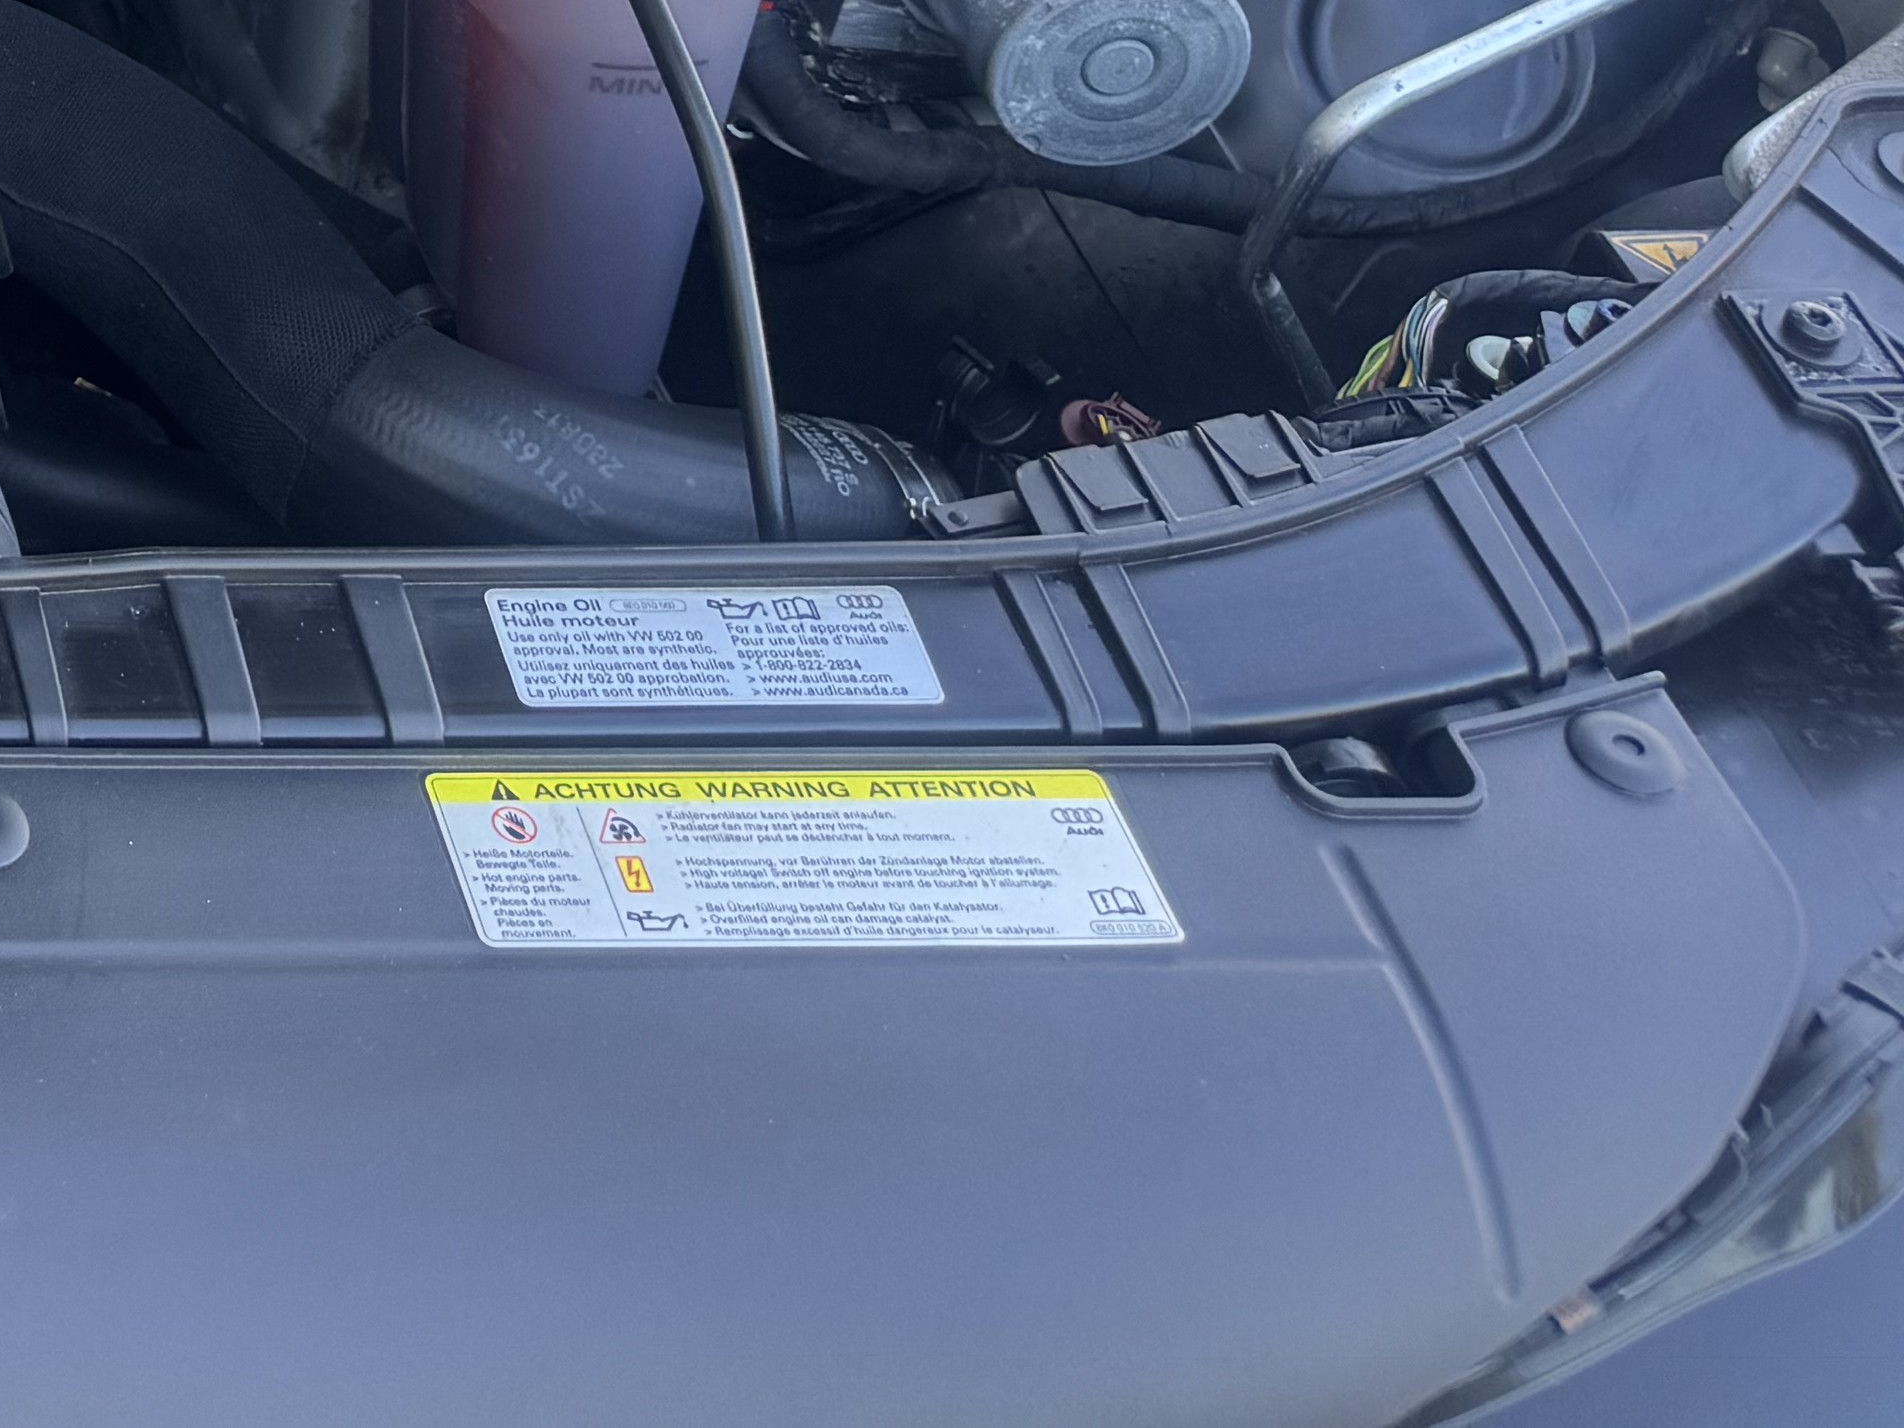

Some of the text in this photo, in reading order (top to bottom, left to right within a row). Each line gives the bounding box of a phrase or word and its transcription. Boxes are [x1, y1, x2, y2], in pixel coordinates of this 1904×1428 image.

[588, 76, 662, 94] MIN
[497, 599, 602, 614] Engine Oil
[502, 615, 639, 627] Huile moteur
[849, 611, 883, 620] Audi
[726, 622, 910, 635] For a list of approved oils:
[507, 630, 703, 644] Use only oil with VW 502 00
[731, 634, 889, 647] Pour une liste d'huiles
[513, 643, 717, 657] approval. Most are synthetic.
[737, 647, 825, 660] approuvées:
[517, 658, 735, 673] Utilisez uniquement des huiles
[755, 659, 862, 671] 1-800-822-2834
[524, 672, 730, 685] avec VW 502 00 approbation.
[759, 673, 893, 684] www.audiusa.com
[526, 685, 733, 700] La plupart sont synthétiques.
[764, 685, 909, 696] www.audicanada.ca
[534, 780, 1036, 799] ACHTUNG WARNING ATTENTION
[666, 810, 896, 821] Kühlerventilator kann jederzeit anlaufen.
[670, 821, 869, 832] Radiator fan may start at any time.
[675, 834, 690, 842] Le
[692, 834, 753, 843] ventilateur
[756, 834, 783, 843] peut
[801, 834, 863, 842] déclencher
[867, 833, 874, 842] à
[876, 833, 900, 842] tout
[902, 834, 956, 842] moment.
[473, 849, 508, 859] Heiße
[476, 860, 527, 870] Bewegte
[684, 857, 777, 868] Hochspannung,
[780, 858, 798, 866] vor
[800, 856, 855, 866] Berühren
[857, 856, 876, 866] der
[949, 856, 986, 865] Motor
[481, 874, 582, 884] Hot engine parts.
[690, 869, 718, 879] High
[770, 868, 810, 878] Switch
[813, 868, 829, 877] off
[832, 868, 872, 879] engine
[874, 868, 913, 877] before
[914, 868, 967, 878] touching
[969, 868, 1013, 878] ignition
[485, 884, 565, 894] Moving parts.
[694, 880, 729, 889] Haute
[732, 879, 779, 890] tension,
[823, 880, 834, 888] le
[837, 880, 879, 888] moteur
[882, 880, 915, 888] avant
[917, 879, 932, 888] de
[933, 879, 978, 888] toucher
[489, 897, 591, 906] Pièces du moteur
[706, 903, 725, 912] Bei
[799, 902, 844, 912] besteht
[846, 901, 886, 912] Gefahr
[889, 902, 905, 911] für
[493, 908, 547, 917] chaudes.
[497, 918, 553, 927] Pièces en
[710, 914, 768, 924] Overfilled
[771, 914, 811, 925] engine
[813, 914, 828, 923] oil
[855, 914, 903, 924] damage
[501, 929, 576, 938] mouvement.
[715, 927, 791, 936] Remplissage
[793, 926, 840, 935] excessif
[843, 926, 884, 935] d'huile
[886, 926, 949, 936] dangereux
[952, 927, 978, 936] pour
[981, 926, 993, 934] le
